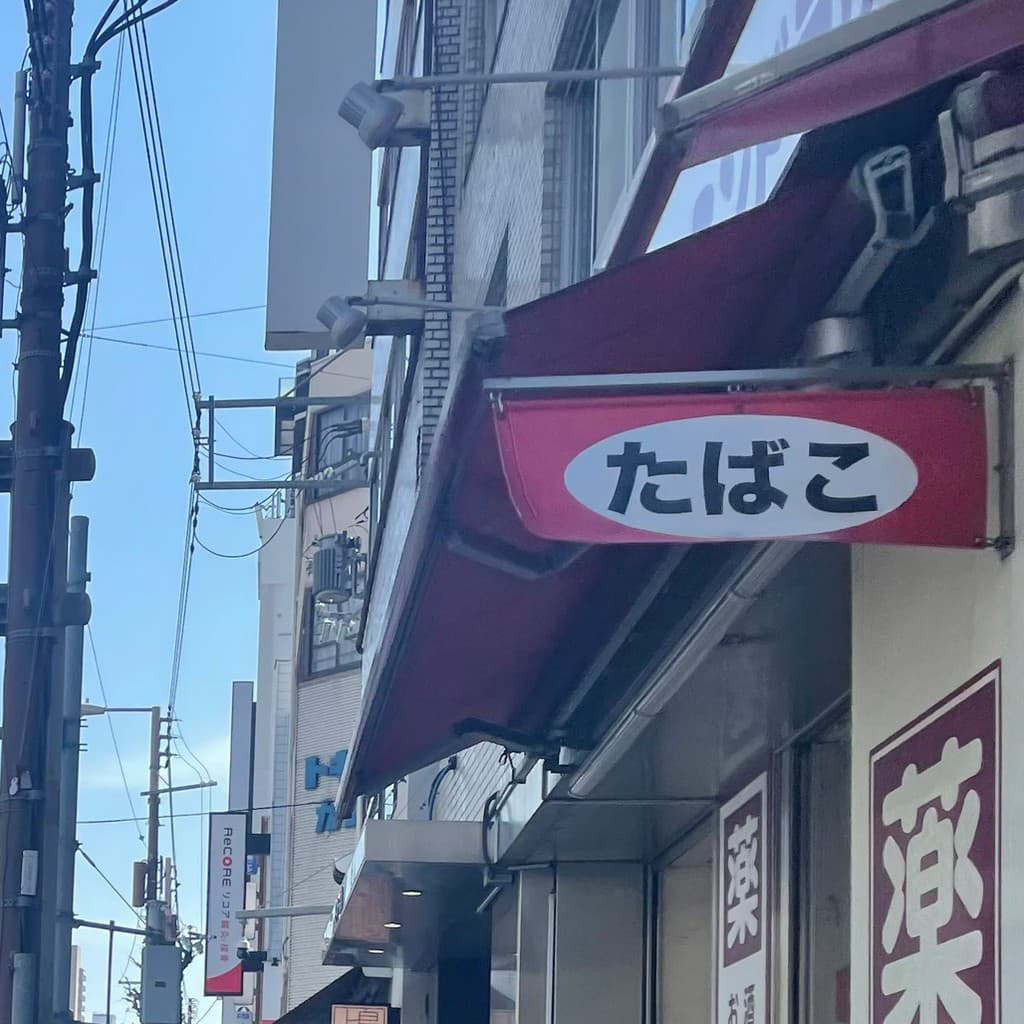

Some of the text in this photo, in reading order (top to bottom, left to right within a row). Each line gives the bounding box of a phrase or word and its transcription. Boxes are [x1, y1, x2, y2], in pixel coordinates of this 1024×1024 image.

[605, 438, 878, 517] たばこ
[727, 813, 759, 949] 薬
